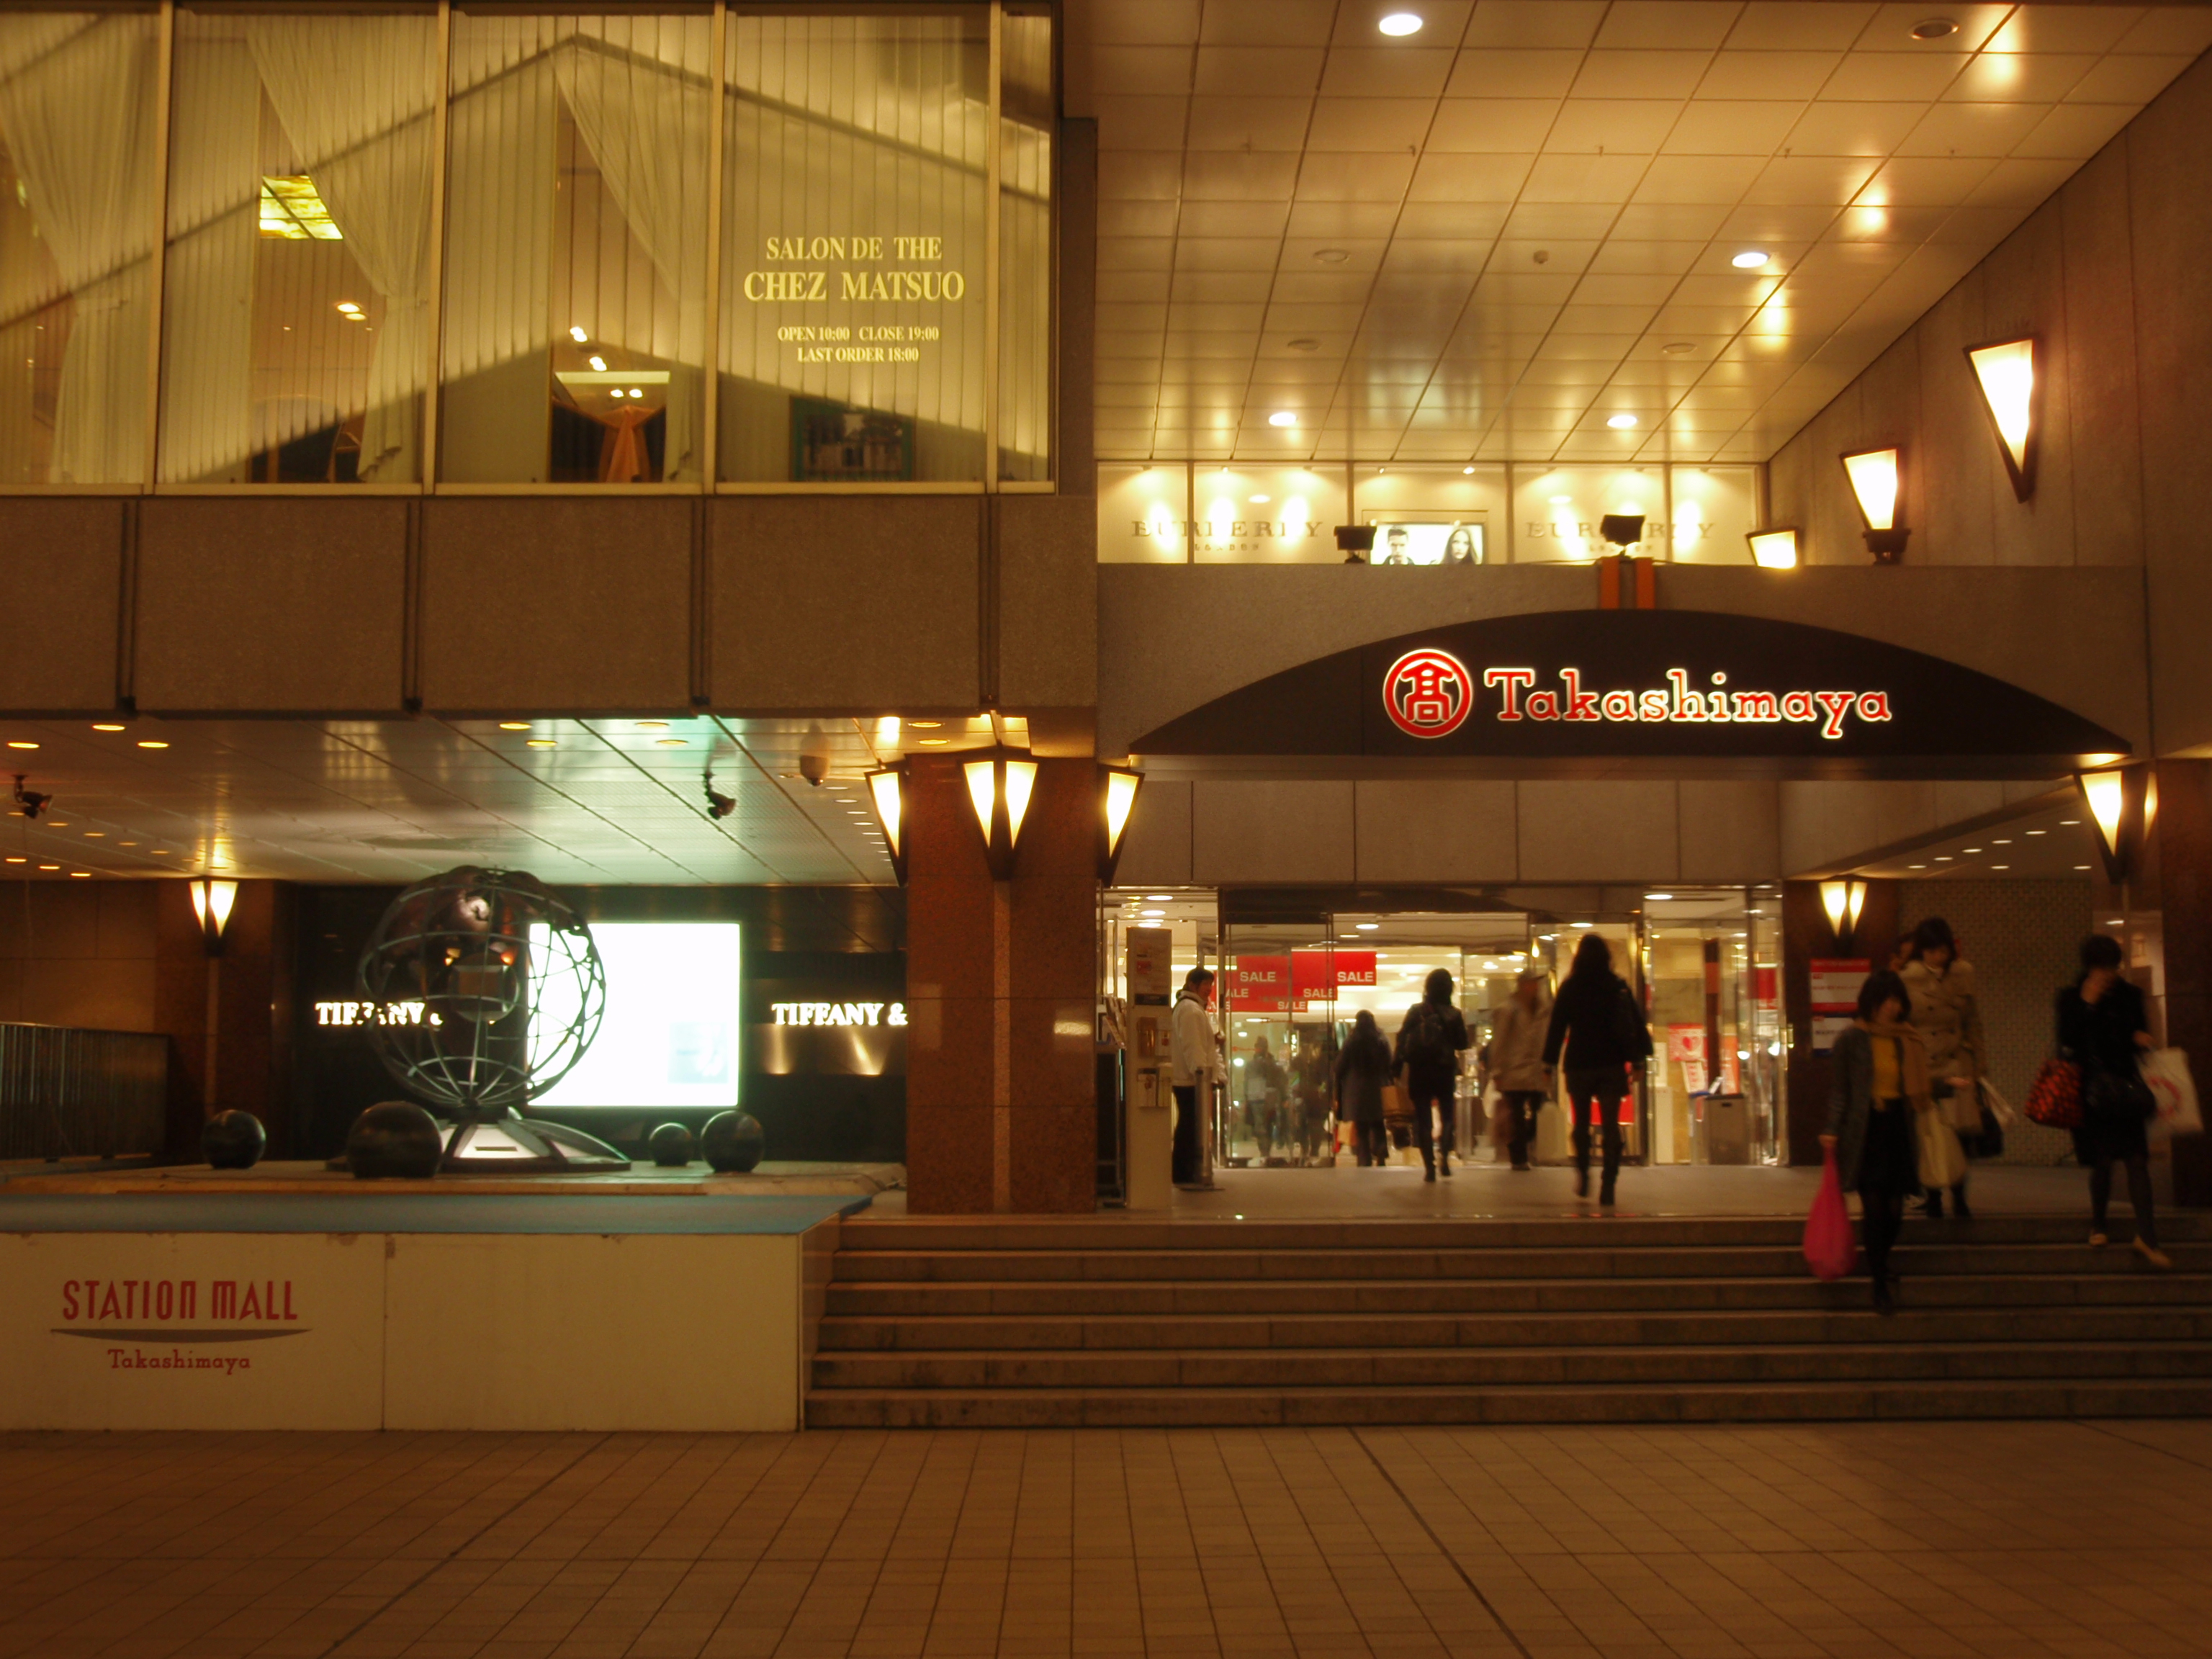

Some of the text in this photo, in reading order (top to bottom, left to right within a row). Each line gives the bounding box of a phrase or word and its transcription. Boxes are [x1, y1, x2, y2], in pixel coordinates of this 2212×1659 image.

[766, 236, 942, 260] SALON DE THE
[744, 271, 964, 301] CHEZ MATSUO
[777, 326, 939, 341] OPEN 10:00 CLOSE 19:00
[797, 347, 919, 362] LAST ORDER 18:00
[1131, 521, 1323, 538] BRERY
[1526, 522, 1714, 539] BURRY
[1484, 667, 1893, 739] Takashimaya
[1239, 971, 1276, 983] SALE
[1337, 971, 1374, 983] SALE
[1226, 989, 1249, 998] ALE
[1303, 989, 1334, 998] SALE
[771, 1002, 909, 1026] TIFFANY &
[63, 1280, 298, 1321] STATION MALL
[107, 1349, 251, 1375] Takashimaya
